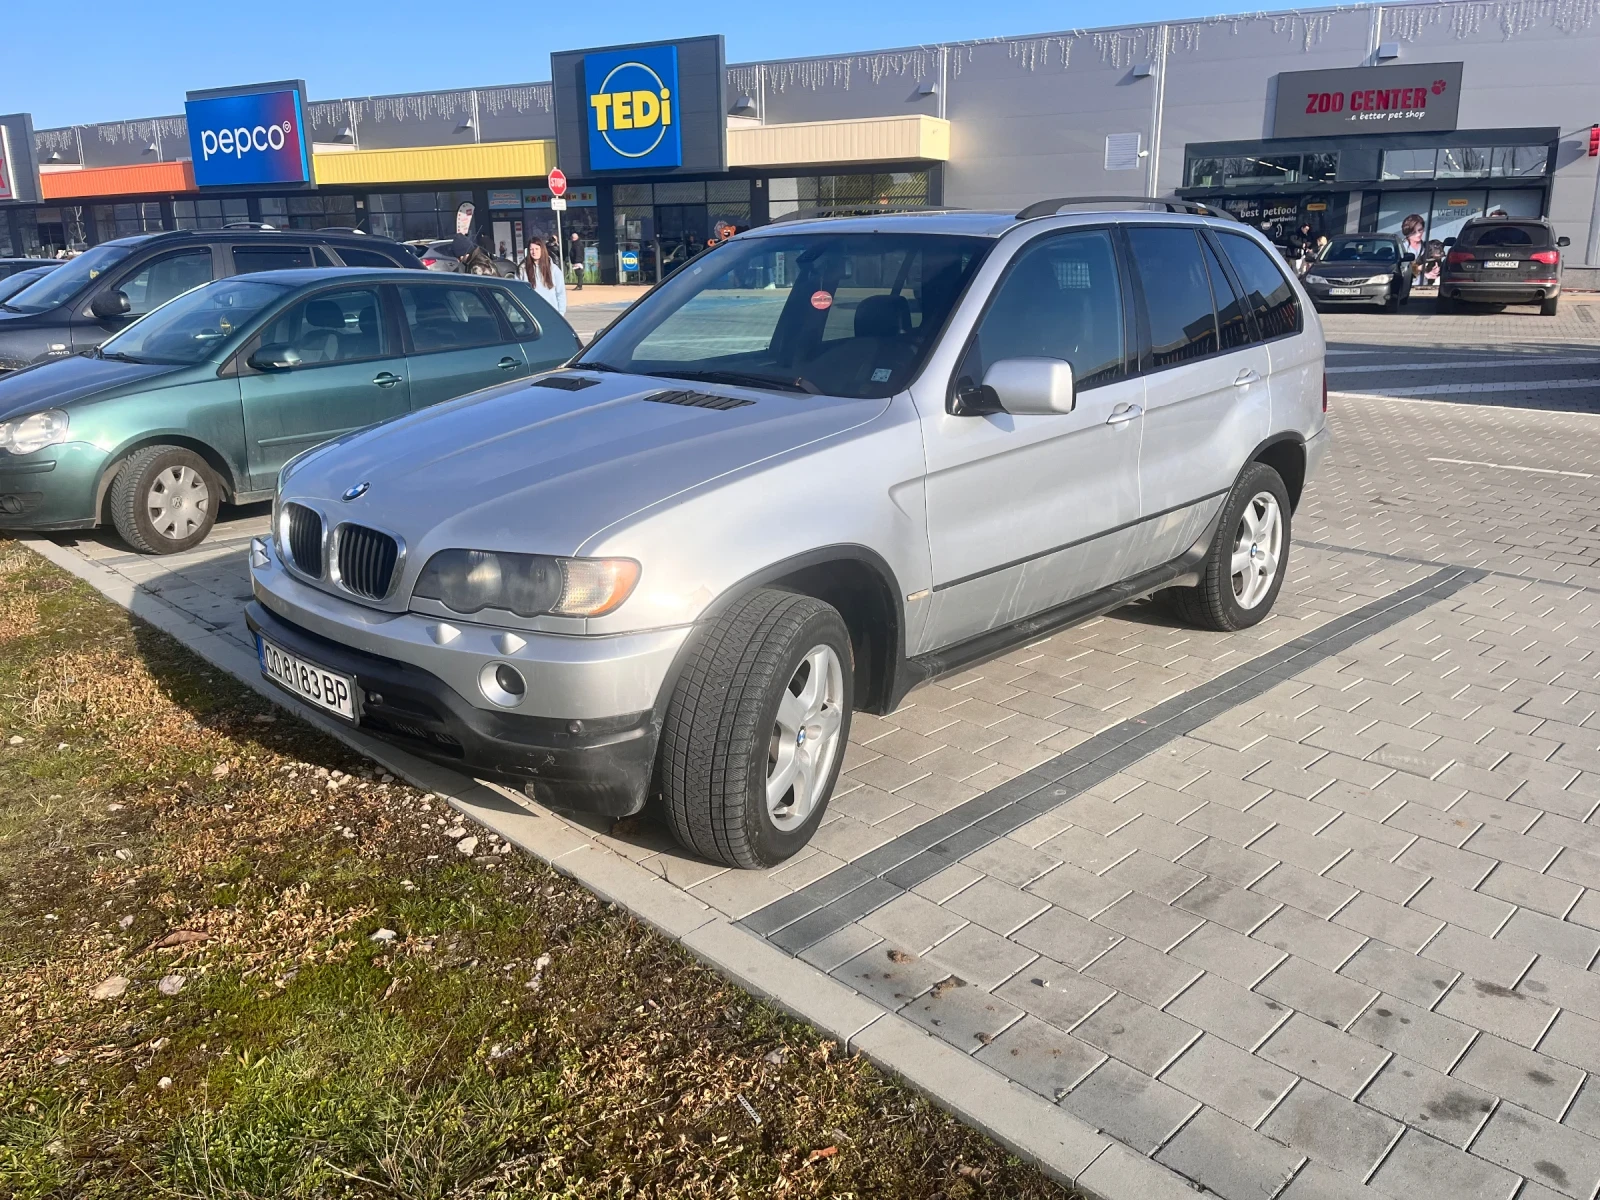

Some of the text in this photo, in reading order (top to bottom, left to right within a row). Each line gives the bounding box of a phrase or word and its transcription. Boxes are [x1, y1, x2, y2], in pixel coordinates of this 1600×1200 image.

[1305, 87, 1428, 114] ZOO CENTER
[590, 87, 671, 131] TEDi
[1359, 111, 1387, 120] better
[1388, 110, 1403, 121] pet
[1405, 110, 1426, 120] shop
[201, 124, 285, 161] pepco
[550, 177, 565, 188] STOP
[1240, 209, 1259, 218] best
[1263, 205, 1297, 217] petfood
[1437, 208, 1477, 217] WE HELP
